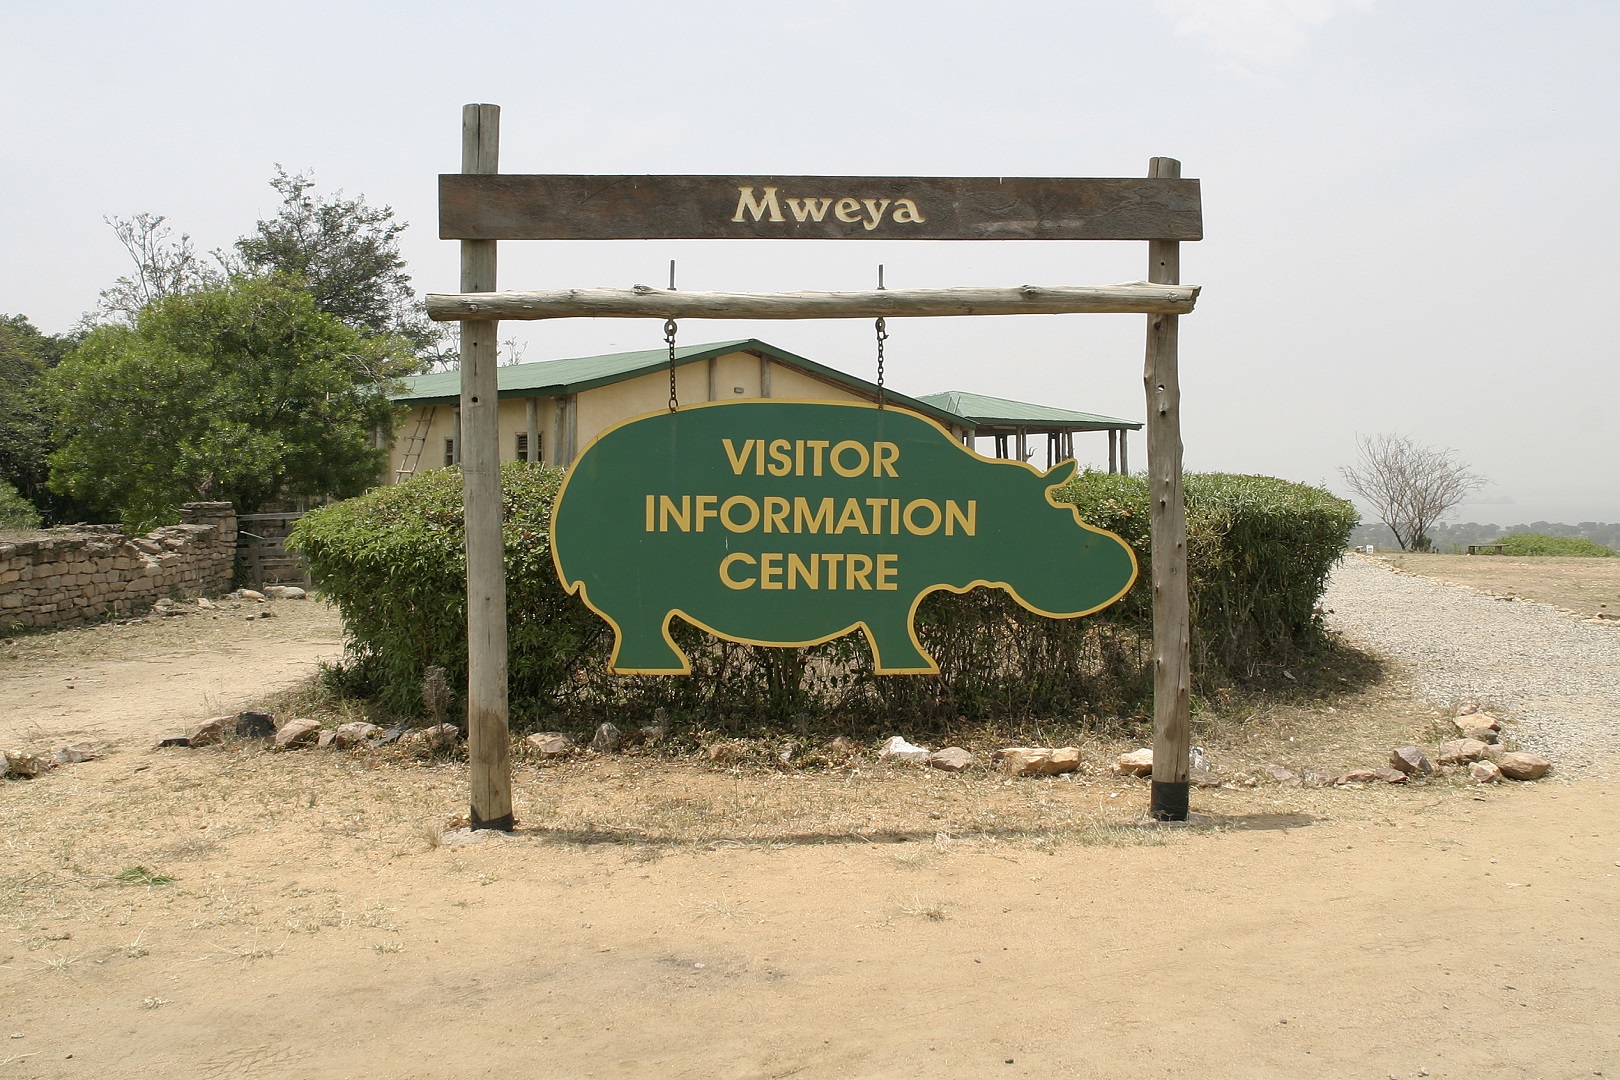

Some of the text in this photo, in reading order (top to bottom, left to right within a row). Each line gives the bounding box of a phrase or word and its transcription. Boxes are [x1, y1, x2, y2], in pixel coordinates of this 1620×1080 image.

[731, 186, 926, 231] Mweya
[722, 439, 900, 478] VISITOR
[645, 495, 977, 537] INFORMATION
[719, 552, 898, 591] CENTRE
